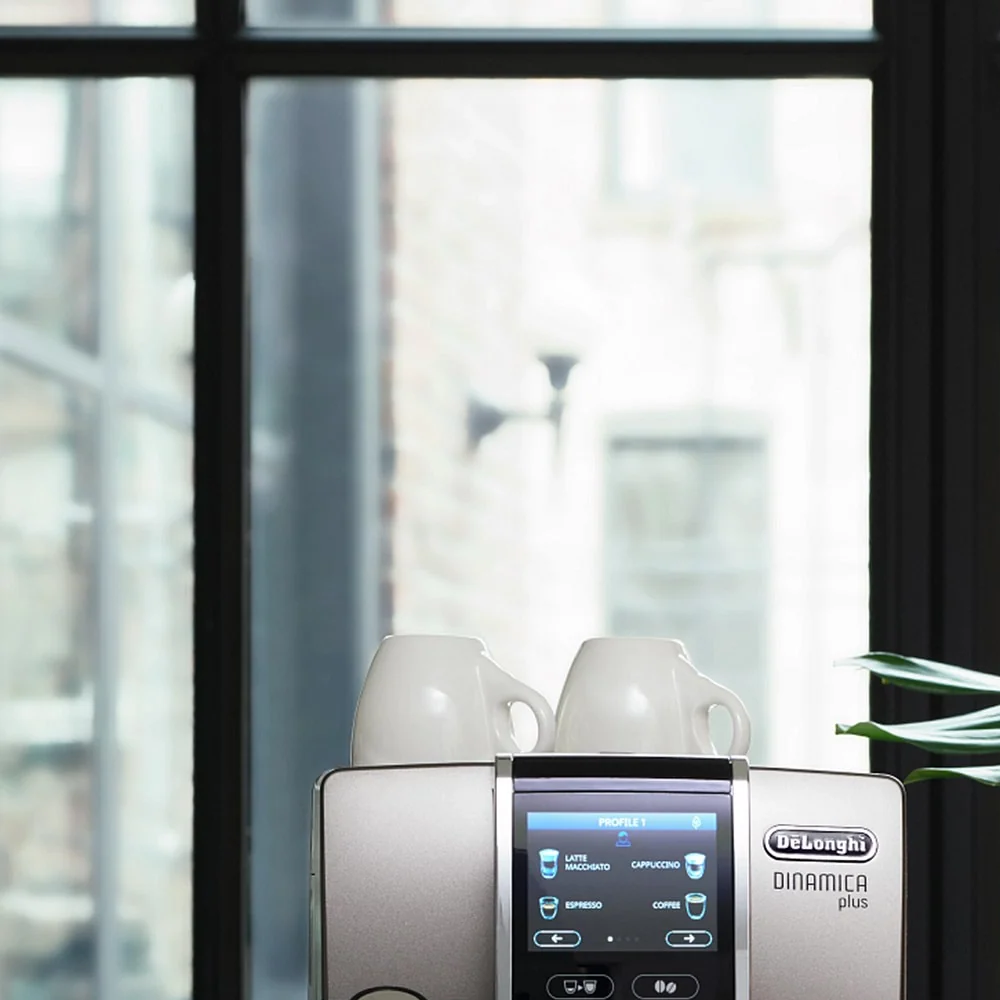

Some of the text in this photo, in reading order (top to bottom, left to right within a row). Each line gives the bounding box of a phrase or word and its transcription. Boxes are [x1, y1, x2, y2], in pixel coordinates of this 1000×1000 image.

[598, 817, 646, 827] PROFILE 1
[565, 854, 587, 862] LATTE
[565, 863, 610, 871] MACCHIATO
[631, 861, 681, 869] CAPPUCCINO
[773, 872, 867, 893] DINAMICA
[565, 901, 602, 909] ESPRESSO
[652, 901, 681, 909] COFFEE
[838, 894, 868, 911] plus
